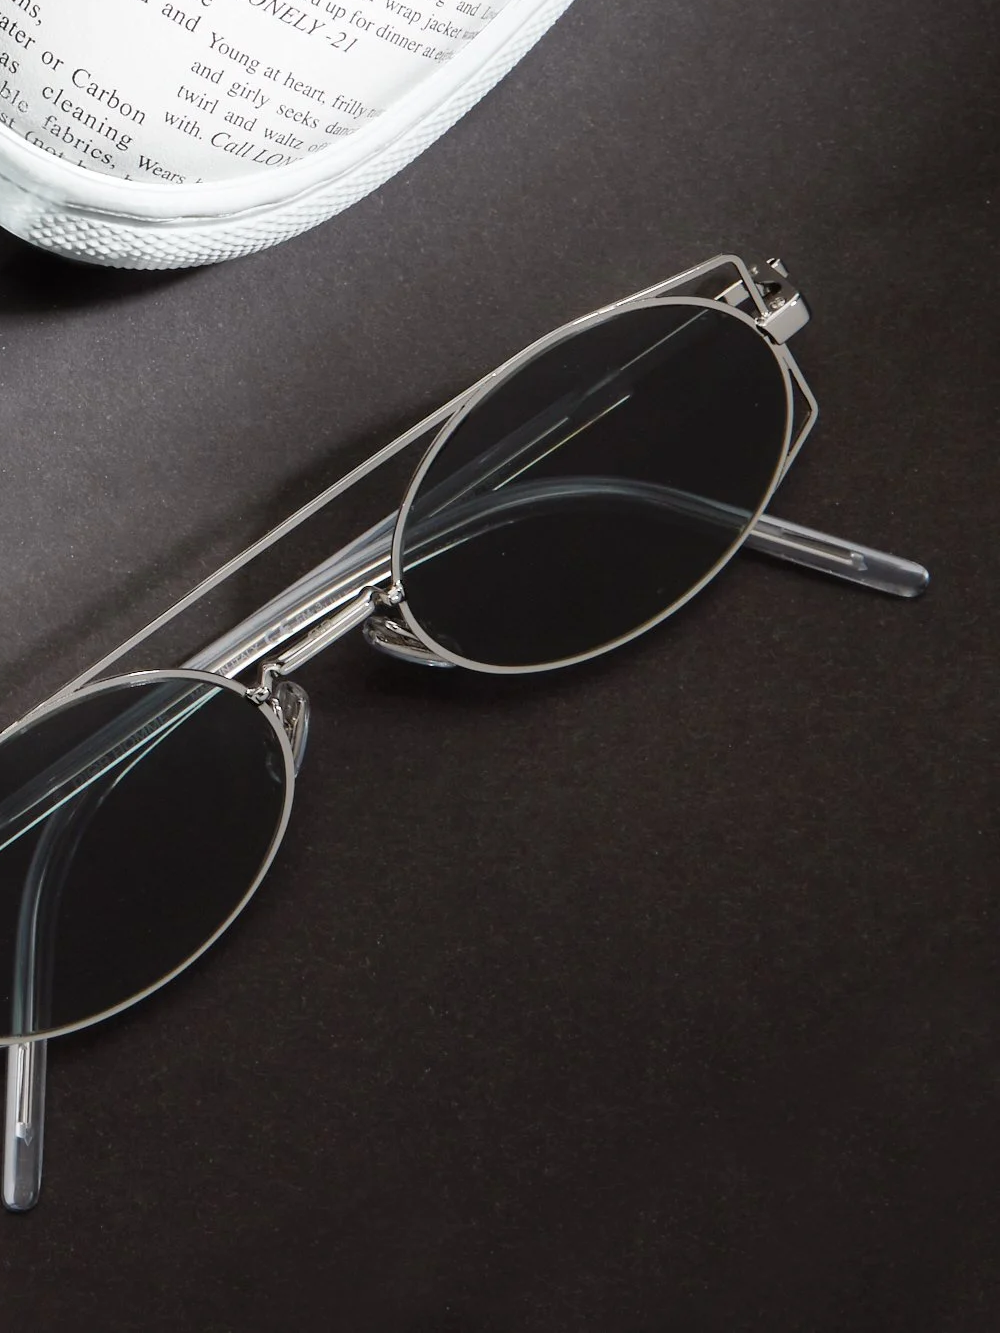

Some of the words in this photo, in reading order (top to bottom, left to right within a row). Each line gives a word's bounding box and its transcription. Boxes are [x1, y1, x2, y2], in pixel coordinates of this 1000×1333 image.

[161, 3, 203, 34] and
[325, 1, 347, 22] up
[349, 11, 375, 31] for
[376, 25, 423, 53] dinner
[41, 50, 66, 72] or
[71, 68, 147, 126] Carbon
[190, 61, 226, 85] and
[226, 82, 271, 110] girly
[276, 104, 321, 130] seeks
[209, 31, 261, 76] Young
[282, 71, 326, 105] heart,
[41, 86, 134, 153] cleaning
[41, 114, 116, 171] fabrics,
[164, 111, 203, 141] with.
[210, 132, 256, 159] Call
[177, 85, 220, 115] twirl
[223, 111, 259, 133] and
[264, 127, 305, 151] waltz
[138, 154, 187, 186] Wears
